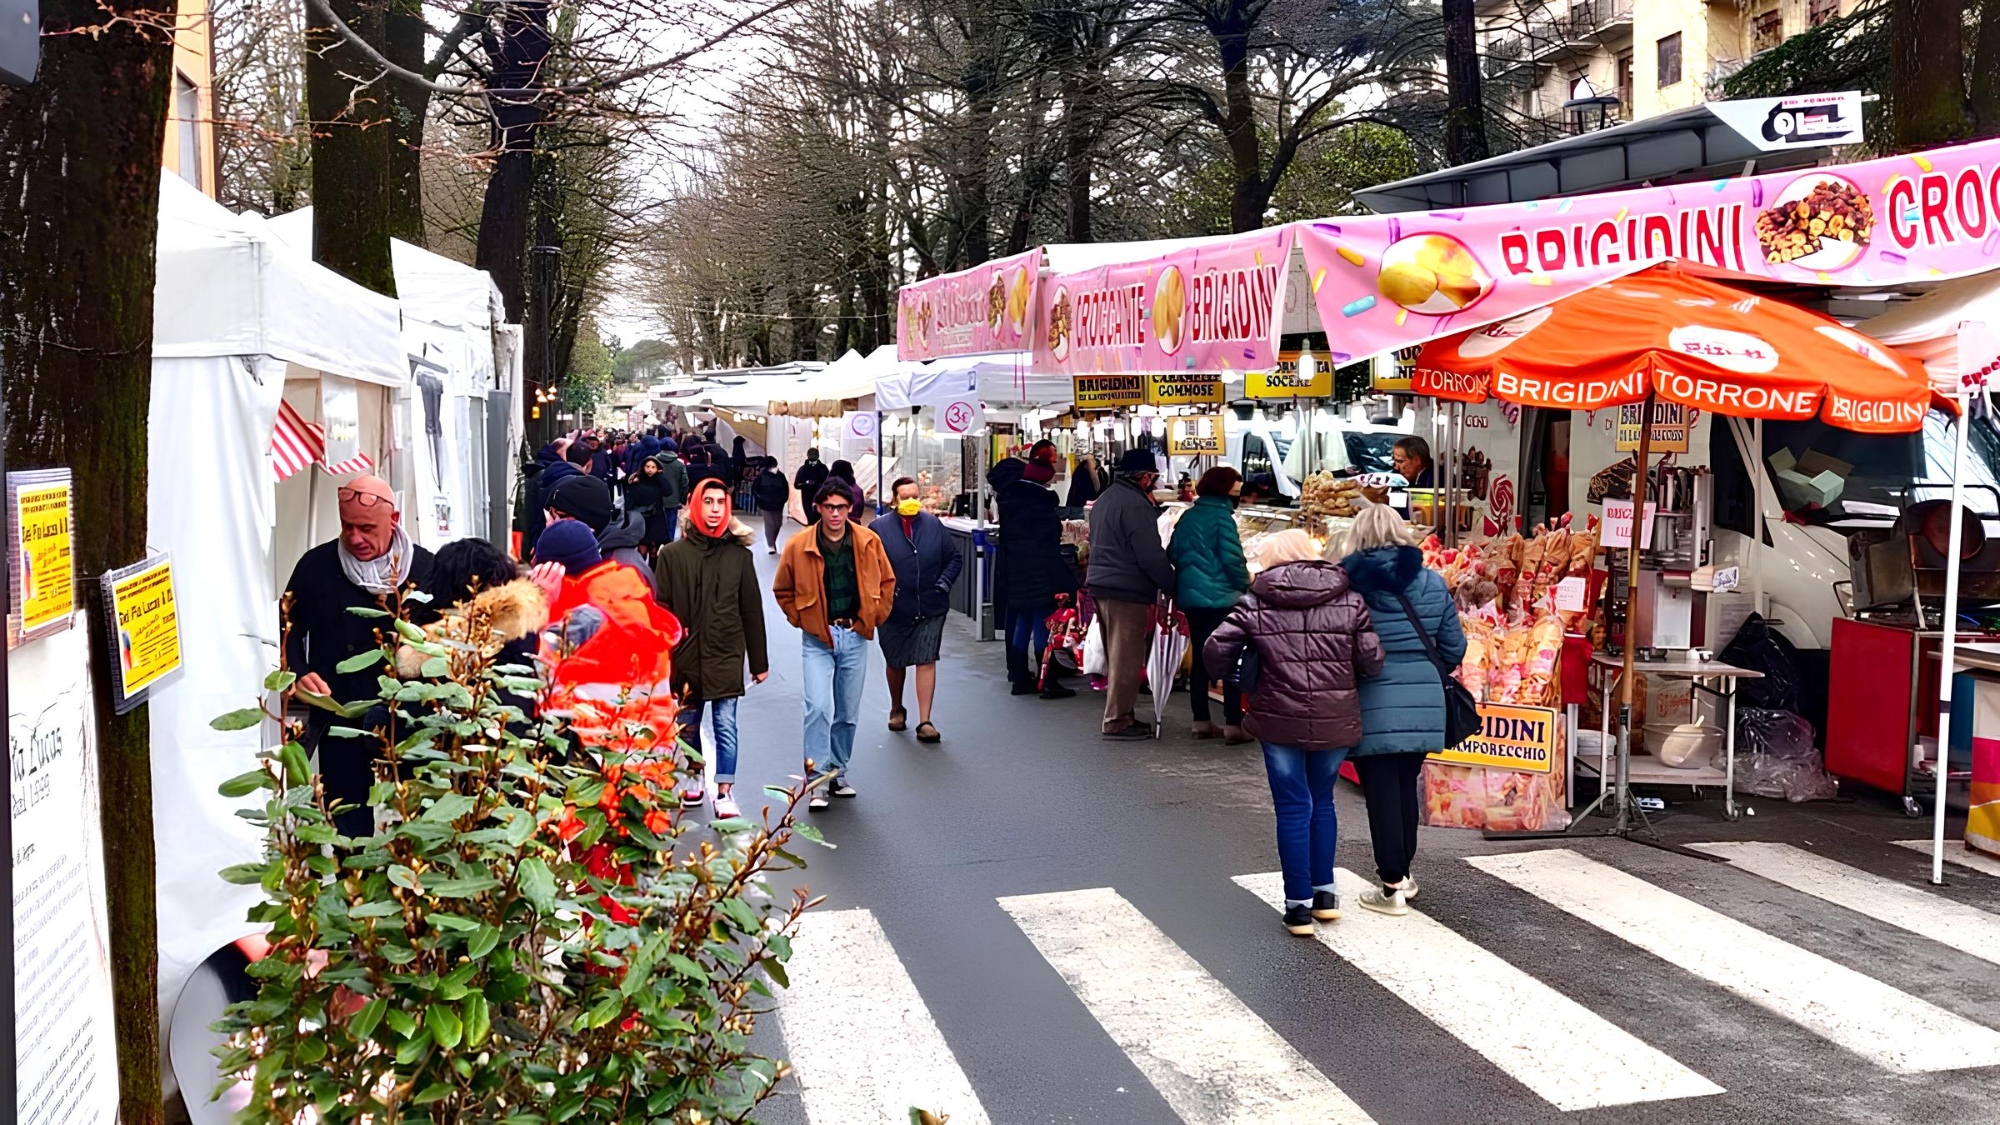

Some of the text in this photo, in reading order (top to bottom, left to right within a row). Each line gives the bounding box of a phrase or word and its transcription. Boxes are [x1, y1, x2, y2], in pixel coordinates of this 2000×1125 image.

[1500, 204, 1746, 276] BRIGIDINI
[1076, 284, 1145, 348] CROCCANTE
[1192, 266, 1277, 342] BRIGIDINI
[1078, 376, 1140, 392] BRIGIDINI
[1496, 372, 1643, 403] BRIGIDINI
[1655, 368, 1817, 413] TORRONE
